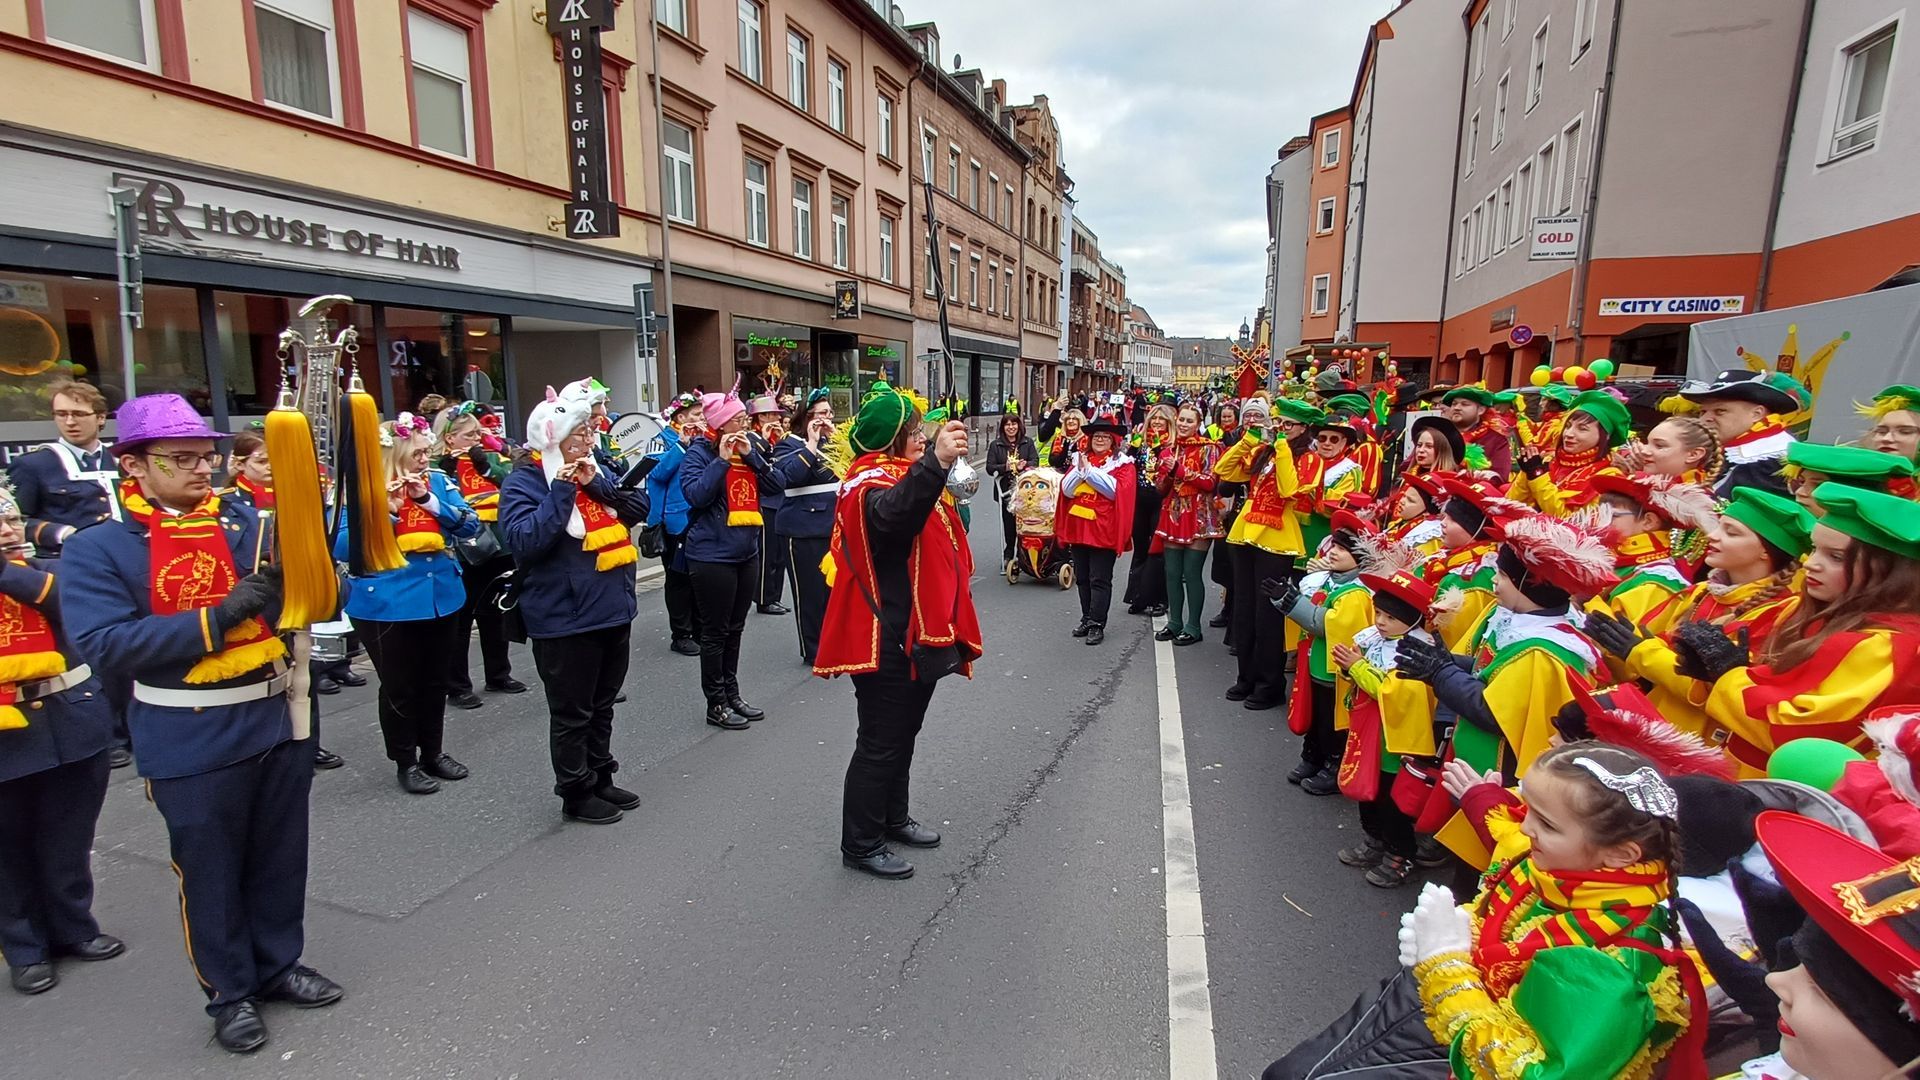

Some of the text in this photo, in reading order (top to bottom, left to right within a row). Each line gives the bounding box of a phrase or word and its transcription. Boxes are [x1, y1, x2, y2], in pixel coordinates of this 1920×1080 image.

[570, 28, 590, 202] HOUSE OF HAIR
[573, 208, 599, 234] ZR
[202, 203, 329, 250] HOUSE
[343, 229, 384, 256] OF
[396, 237, 462, 272] HAIR
[1537, 232, 1574, 244] GOLD
[1620, 298, 1721, 313] CITY CASINO
[620, 421, 641, 439] SONOR
